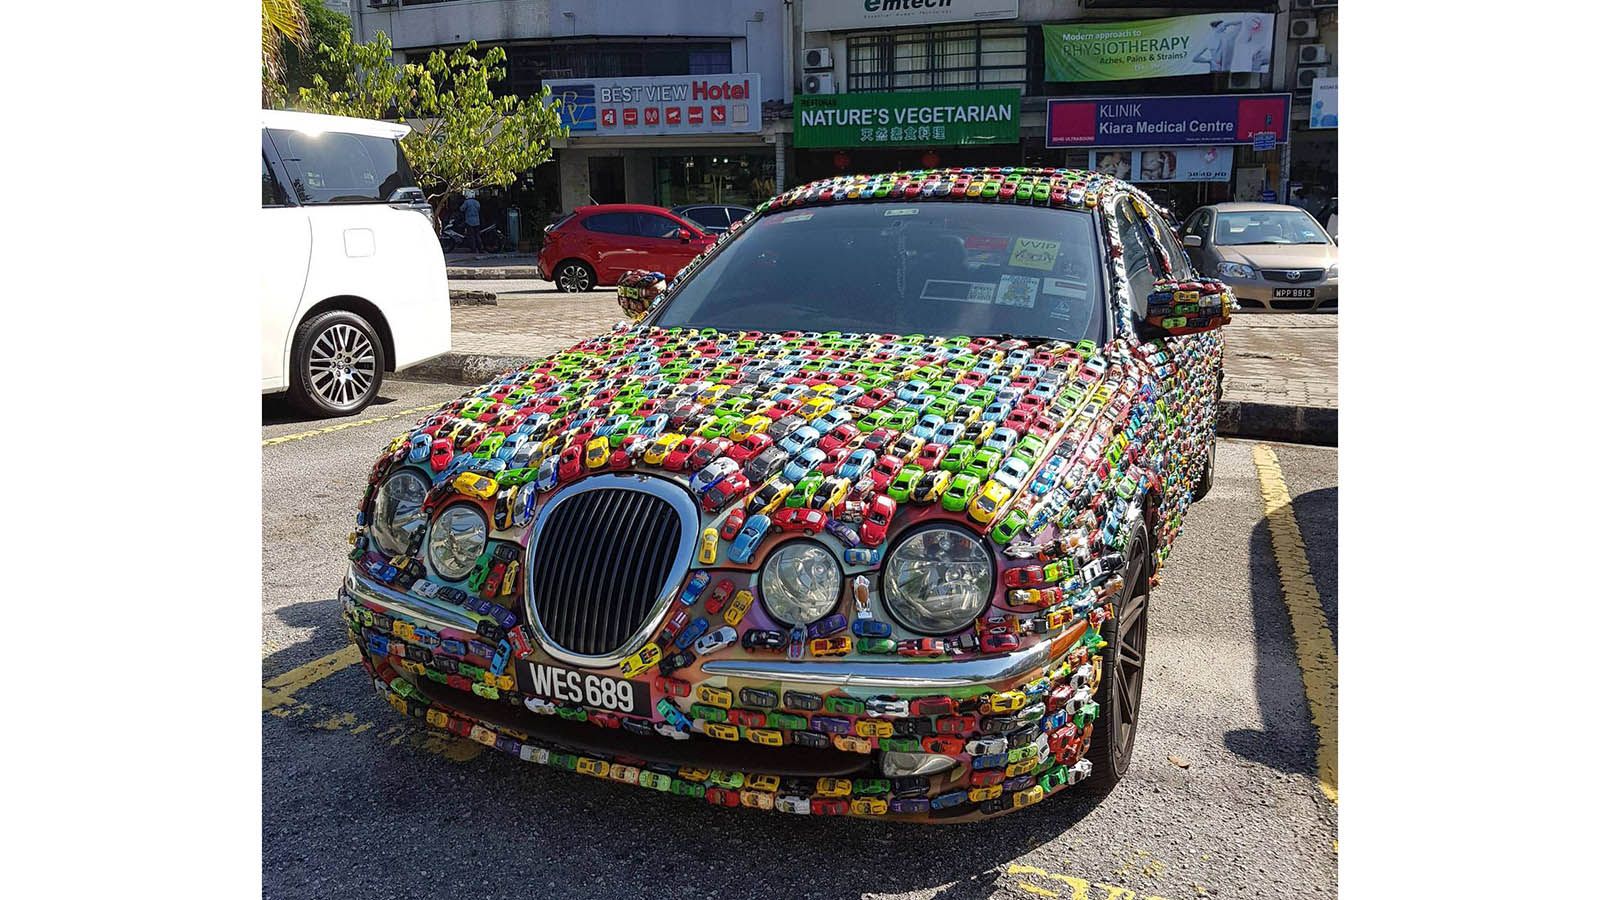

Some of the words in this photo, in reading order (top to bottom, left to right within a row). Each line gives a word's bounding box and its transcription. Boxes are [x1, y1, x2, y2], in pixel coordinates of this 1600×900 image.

[1062, 31, 1094, 41] Modern
[1096, 30, 1130, 42] approach
[1131, 29, 1142, 38] to
[1062, 36, 1191, 56] PHYSIOTHERAPY
[1100, 55, 1125, 65] Aches,
[1127, 54, 1147, 63] Pains
[1148, 53, 1155, 62] &
[1157, 51, 1188, 61] Strains?
[601, 87, 642, 102] BEST
[644, 84, 688, 101] VIEW
[692, 79, 749, 100] Hotel
[801, 108, 889, 127] NATURE'S
[894, 104, 1012, 124] VEGETARIAN
[1100, 103, 1142, 118] KLINIK
[1099, 121, 1134, 134] Kiara
[1136, 120, 1186, 133] Medical
[1188, 120, 1234, 132] Centre
[1021, 239, 1057, 250] VVIP
[529, 662, 583, 703] WES
[585, 675, 634, 712] 689
